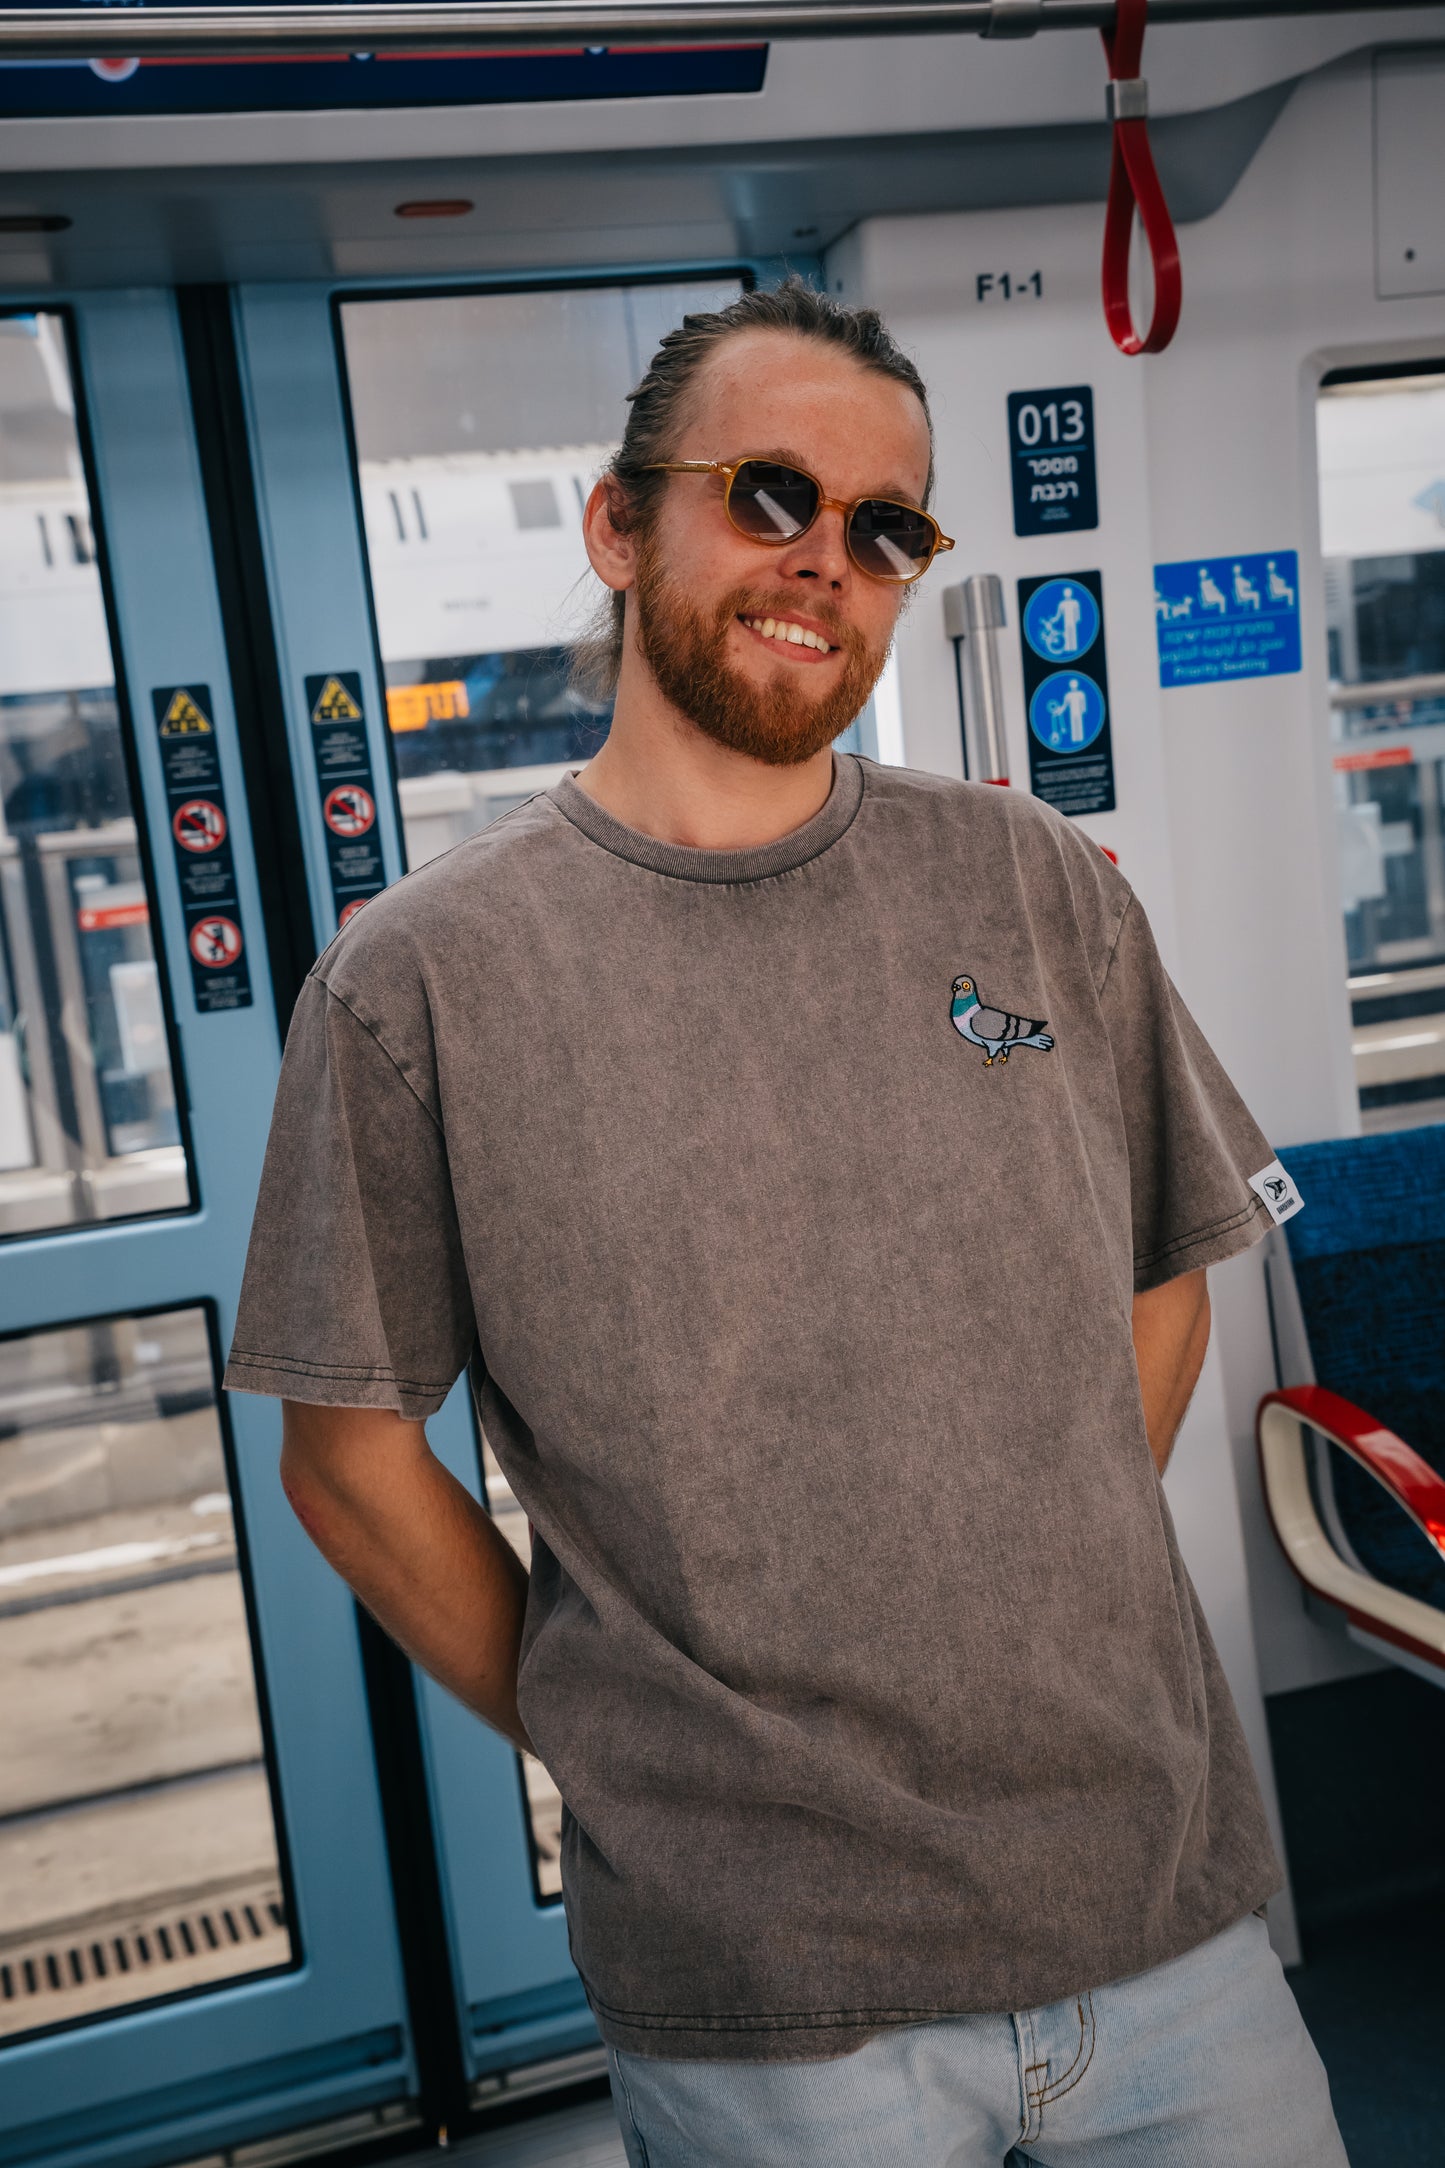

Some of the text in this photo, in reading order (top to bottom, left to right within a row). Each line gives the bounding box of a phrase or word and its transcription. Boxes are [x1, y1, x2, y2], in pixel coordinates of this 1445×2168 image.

[976, 271, 1042, 301] F1-1
[1017, 400, 1085, 445] 013
[1028, 456, 1078, 476] מספר
[1031, 481, 1079, 502] רכבת
